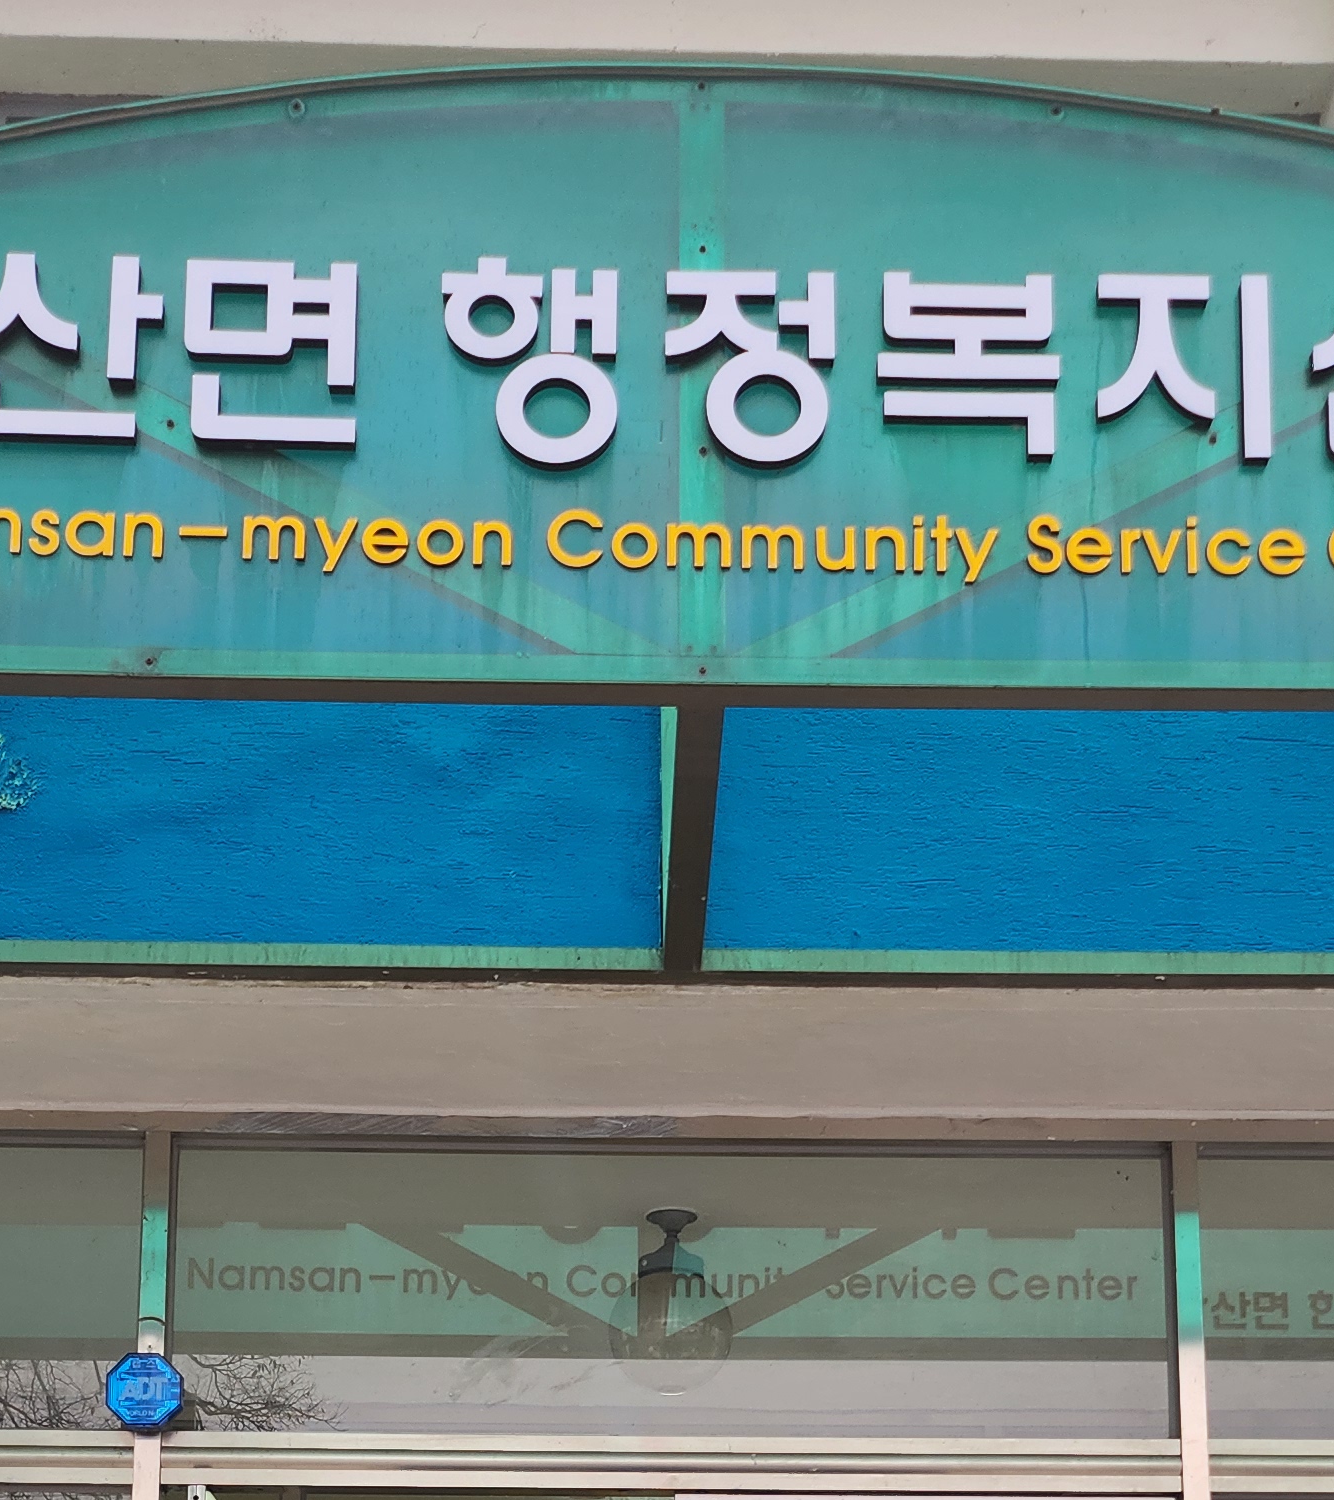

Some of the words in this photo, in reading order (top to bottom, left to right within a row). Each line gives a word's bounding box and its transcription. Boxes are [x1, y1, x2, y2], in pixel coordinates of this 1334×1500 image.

[547, 508, 999, 583] Community
[1026, 514, 1306, 577] Service
[988, 1266, 1138, 1301] Center
[1201, 1291, 1289, 1331] 산면
[119, 1376, 168, 1401] ADT
